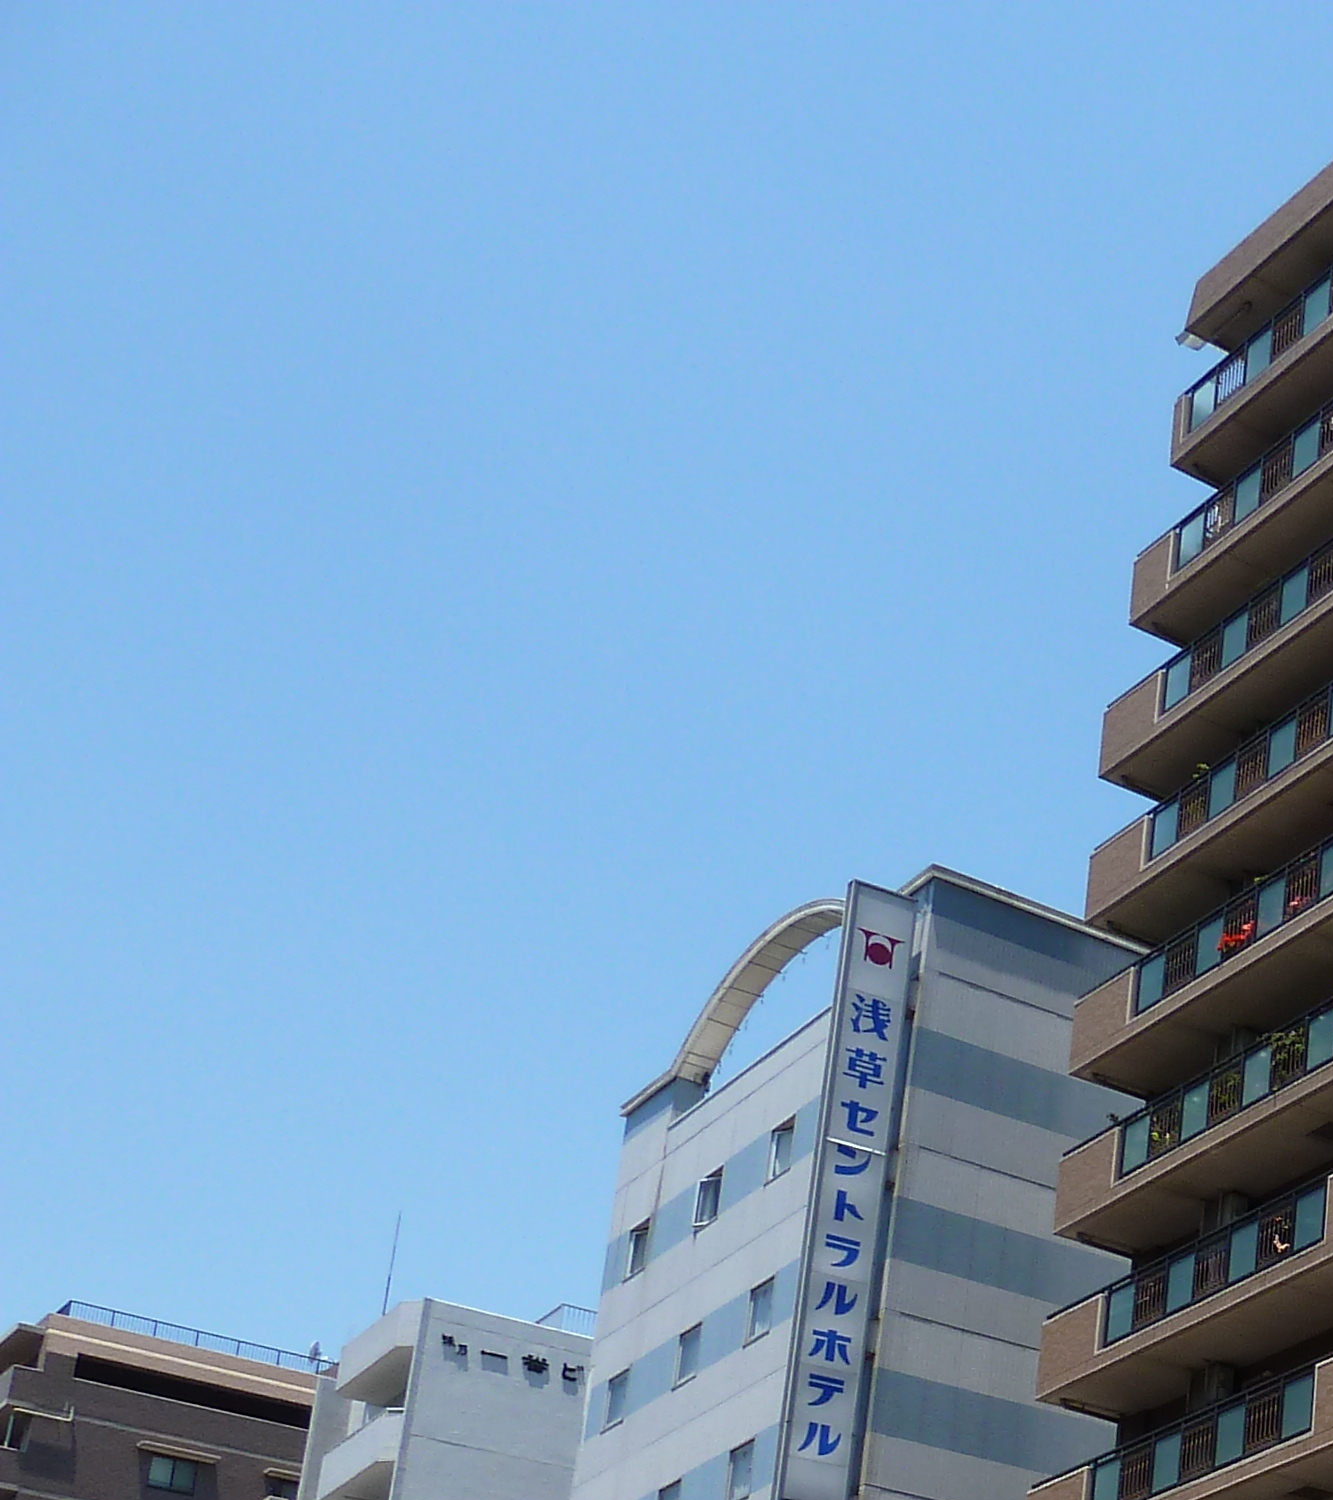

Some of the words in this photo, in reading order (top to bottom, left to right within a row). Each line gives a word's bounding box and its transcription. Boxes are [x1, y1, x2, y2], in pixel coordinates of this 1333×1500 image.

[797, 993, 892, 1457] 浅草セントラルホテル
